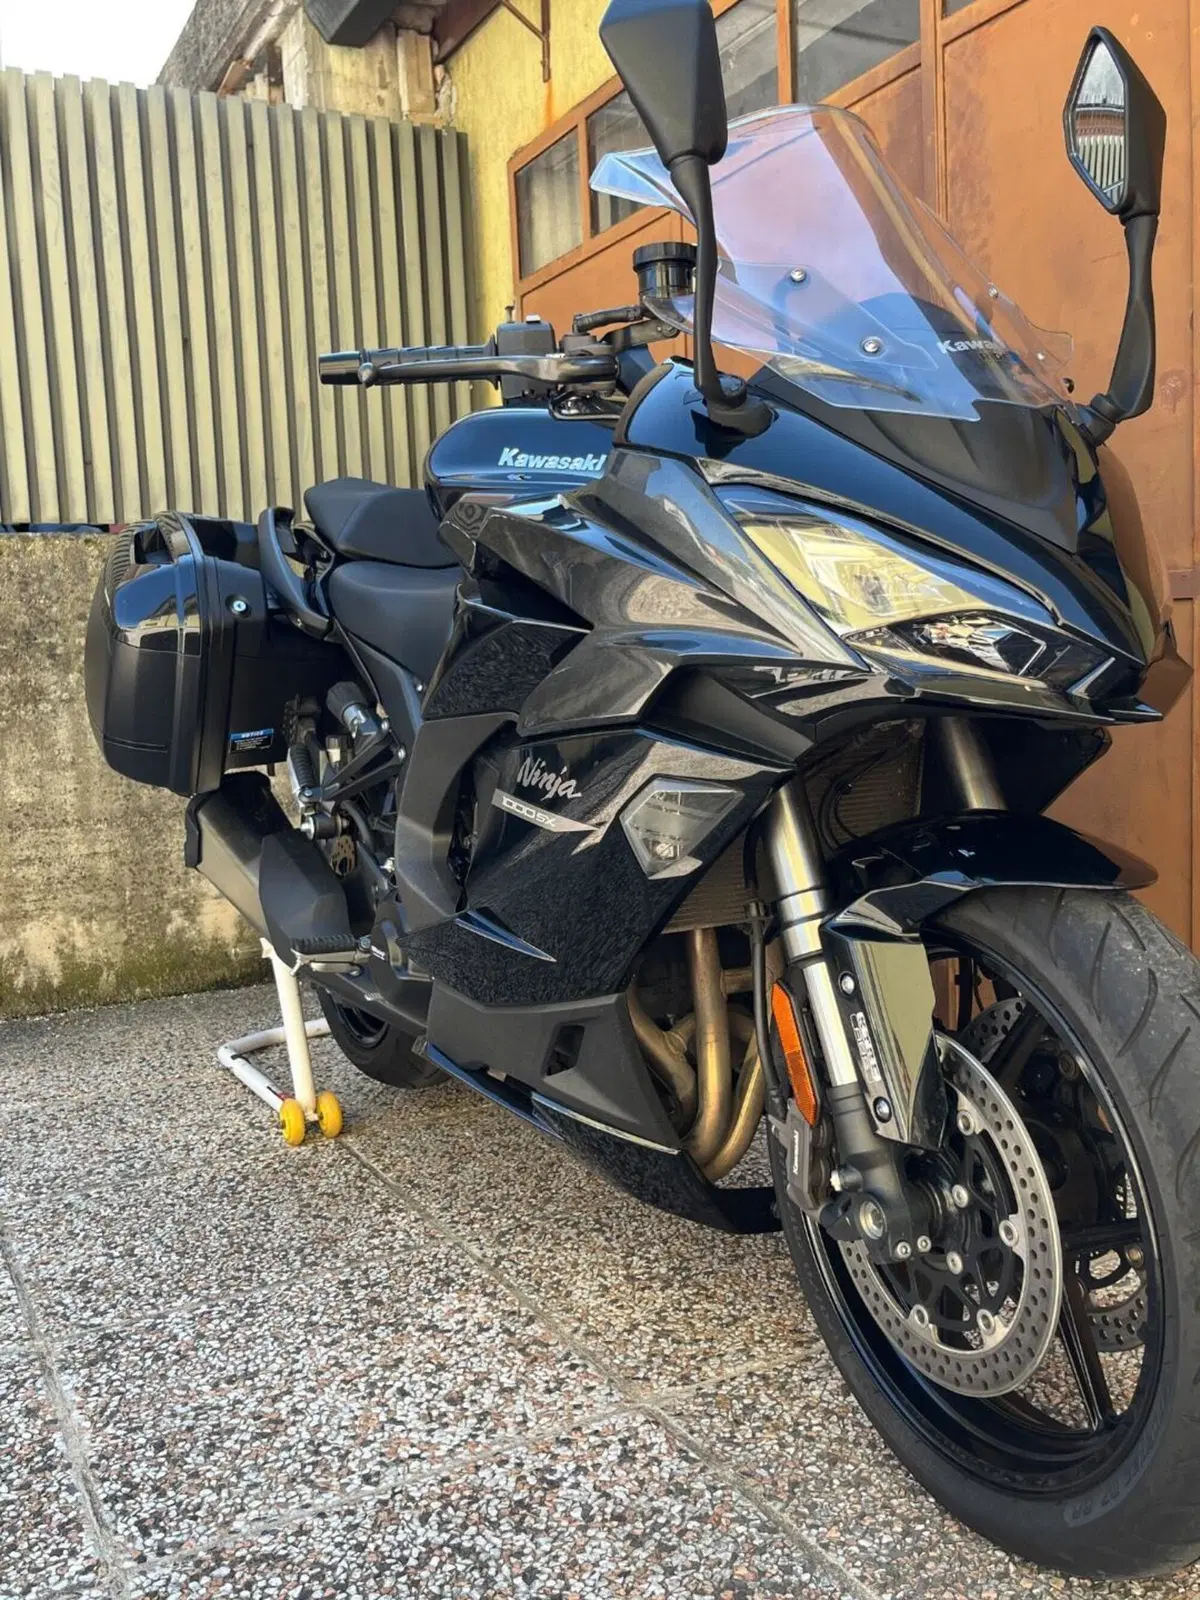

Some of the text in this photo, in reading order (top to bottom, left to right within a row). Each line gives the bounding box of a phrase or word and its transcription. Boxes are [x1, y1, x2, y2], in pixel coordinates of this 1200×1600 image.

[498, 447, 607, 471] Kawasaki
[516, 757, 582, 801] Ninja
[502, 796, 557, 828] 1000SX
